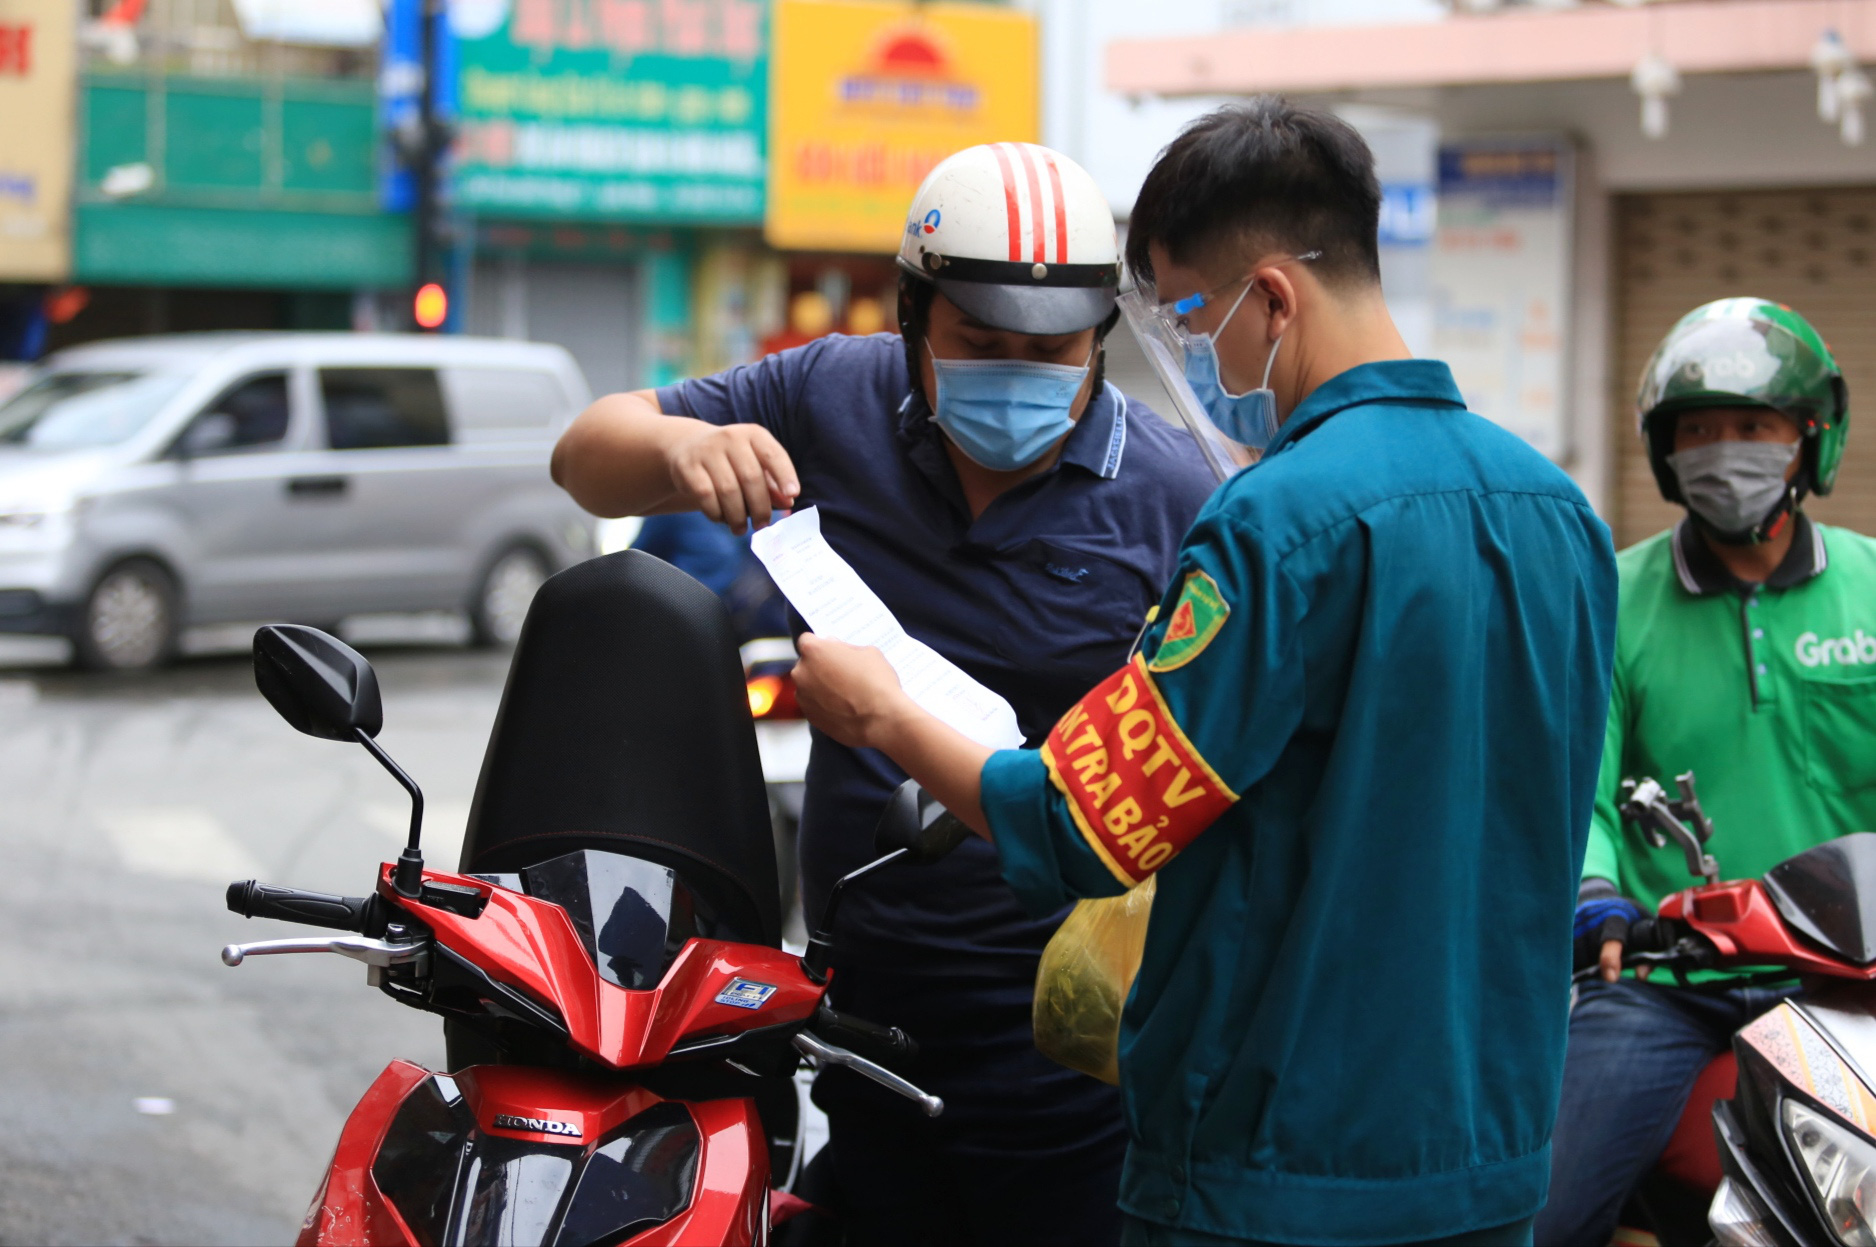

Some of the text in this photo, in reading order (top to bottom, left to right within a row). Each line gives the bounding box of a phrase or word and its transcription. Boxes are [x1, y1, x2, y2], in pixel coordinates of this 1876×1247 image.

[1795, 629, 1876, 667] Grab
[1105, 673, 1206, 808] DQTV
[494, 1114, 582, 1136] HONDA
